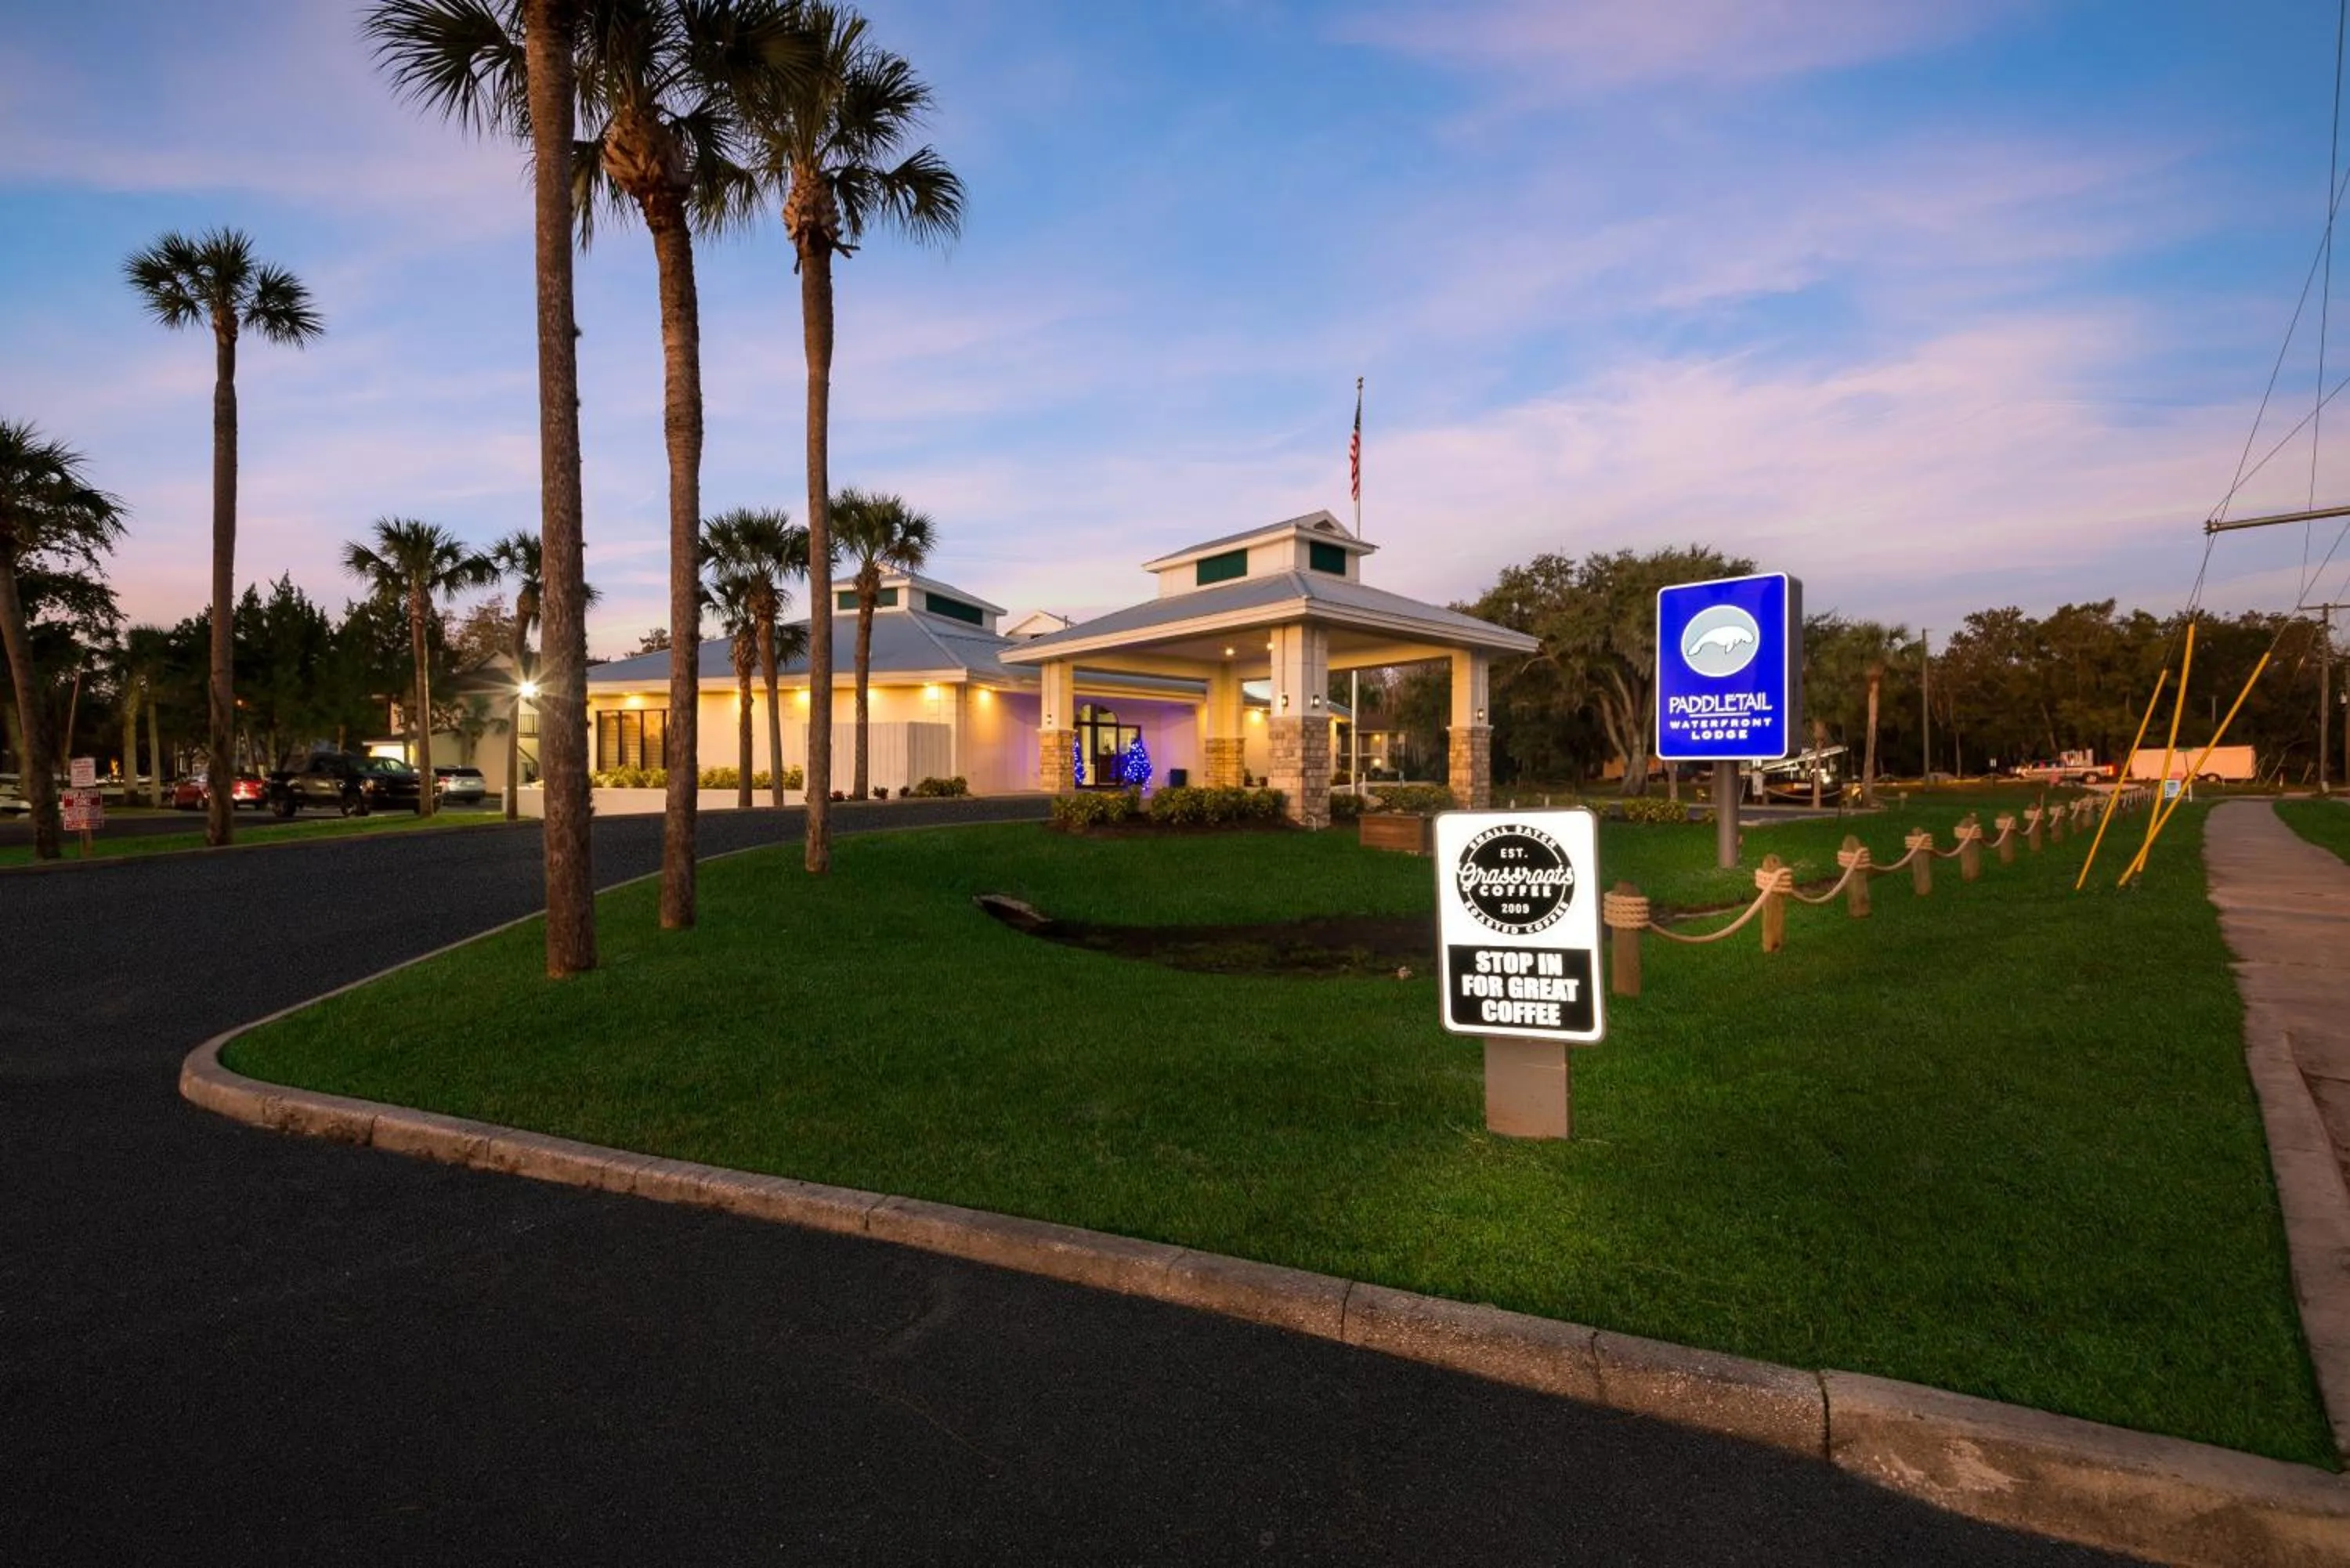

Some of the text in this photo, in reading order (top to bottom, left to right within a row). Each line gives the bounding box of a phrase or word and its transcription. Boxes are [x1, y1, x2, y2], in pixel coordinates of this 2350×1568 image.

[1669, 692, 1773, 714] PADDLETAIL
[1669, 717, 1772, 729] WATERFRONT
[1691, 729, 1748, 740] LODGE
[1469, 825, 1556, 850] SMALL BATCH
[1500, 847, 1528, 859] EST.
[1457, 862, 1574, 892] Grassroots
[1478, 884, 1552, 897] COFFEE
[1464, 901, 1519, 934] ROASTED
[1501, 903, 1530, 914] 2009
[1475, 950, 1563, 977] STOP IN
[1461, 974, 1579, 1002] FOR GREAT
[1481, 999, 1561, 1027] COFFEE
